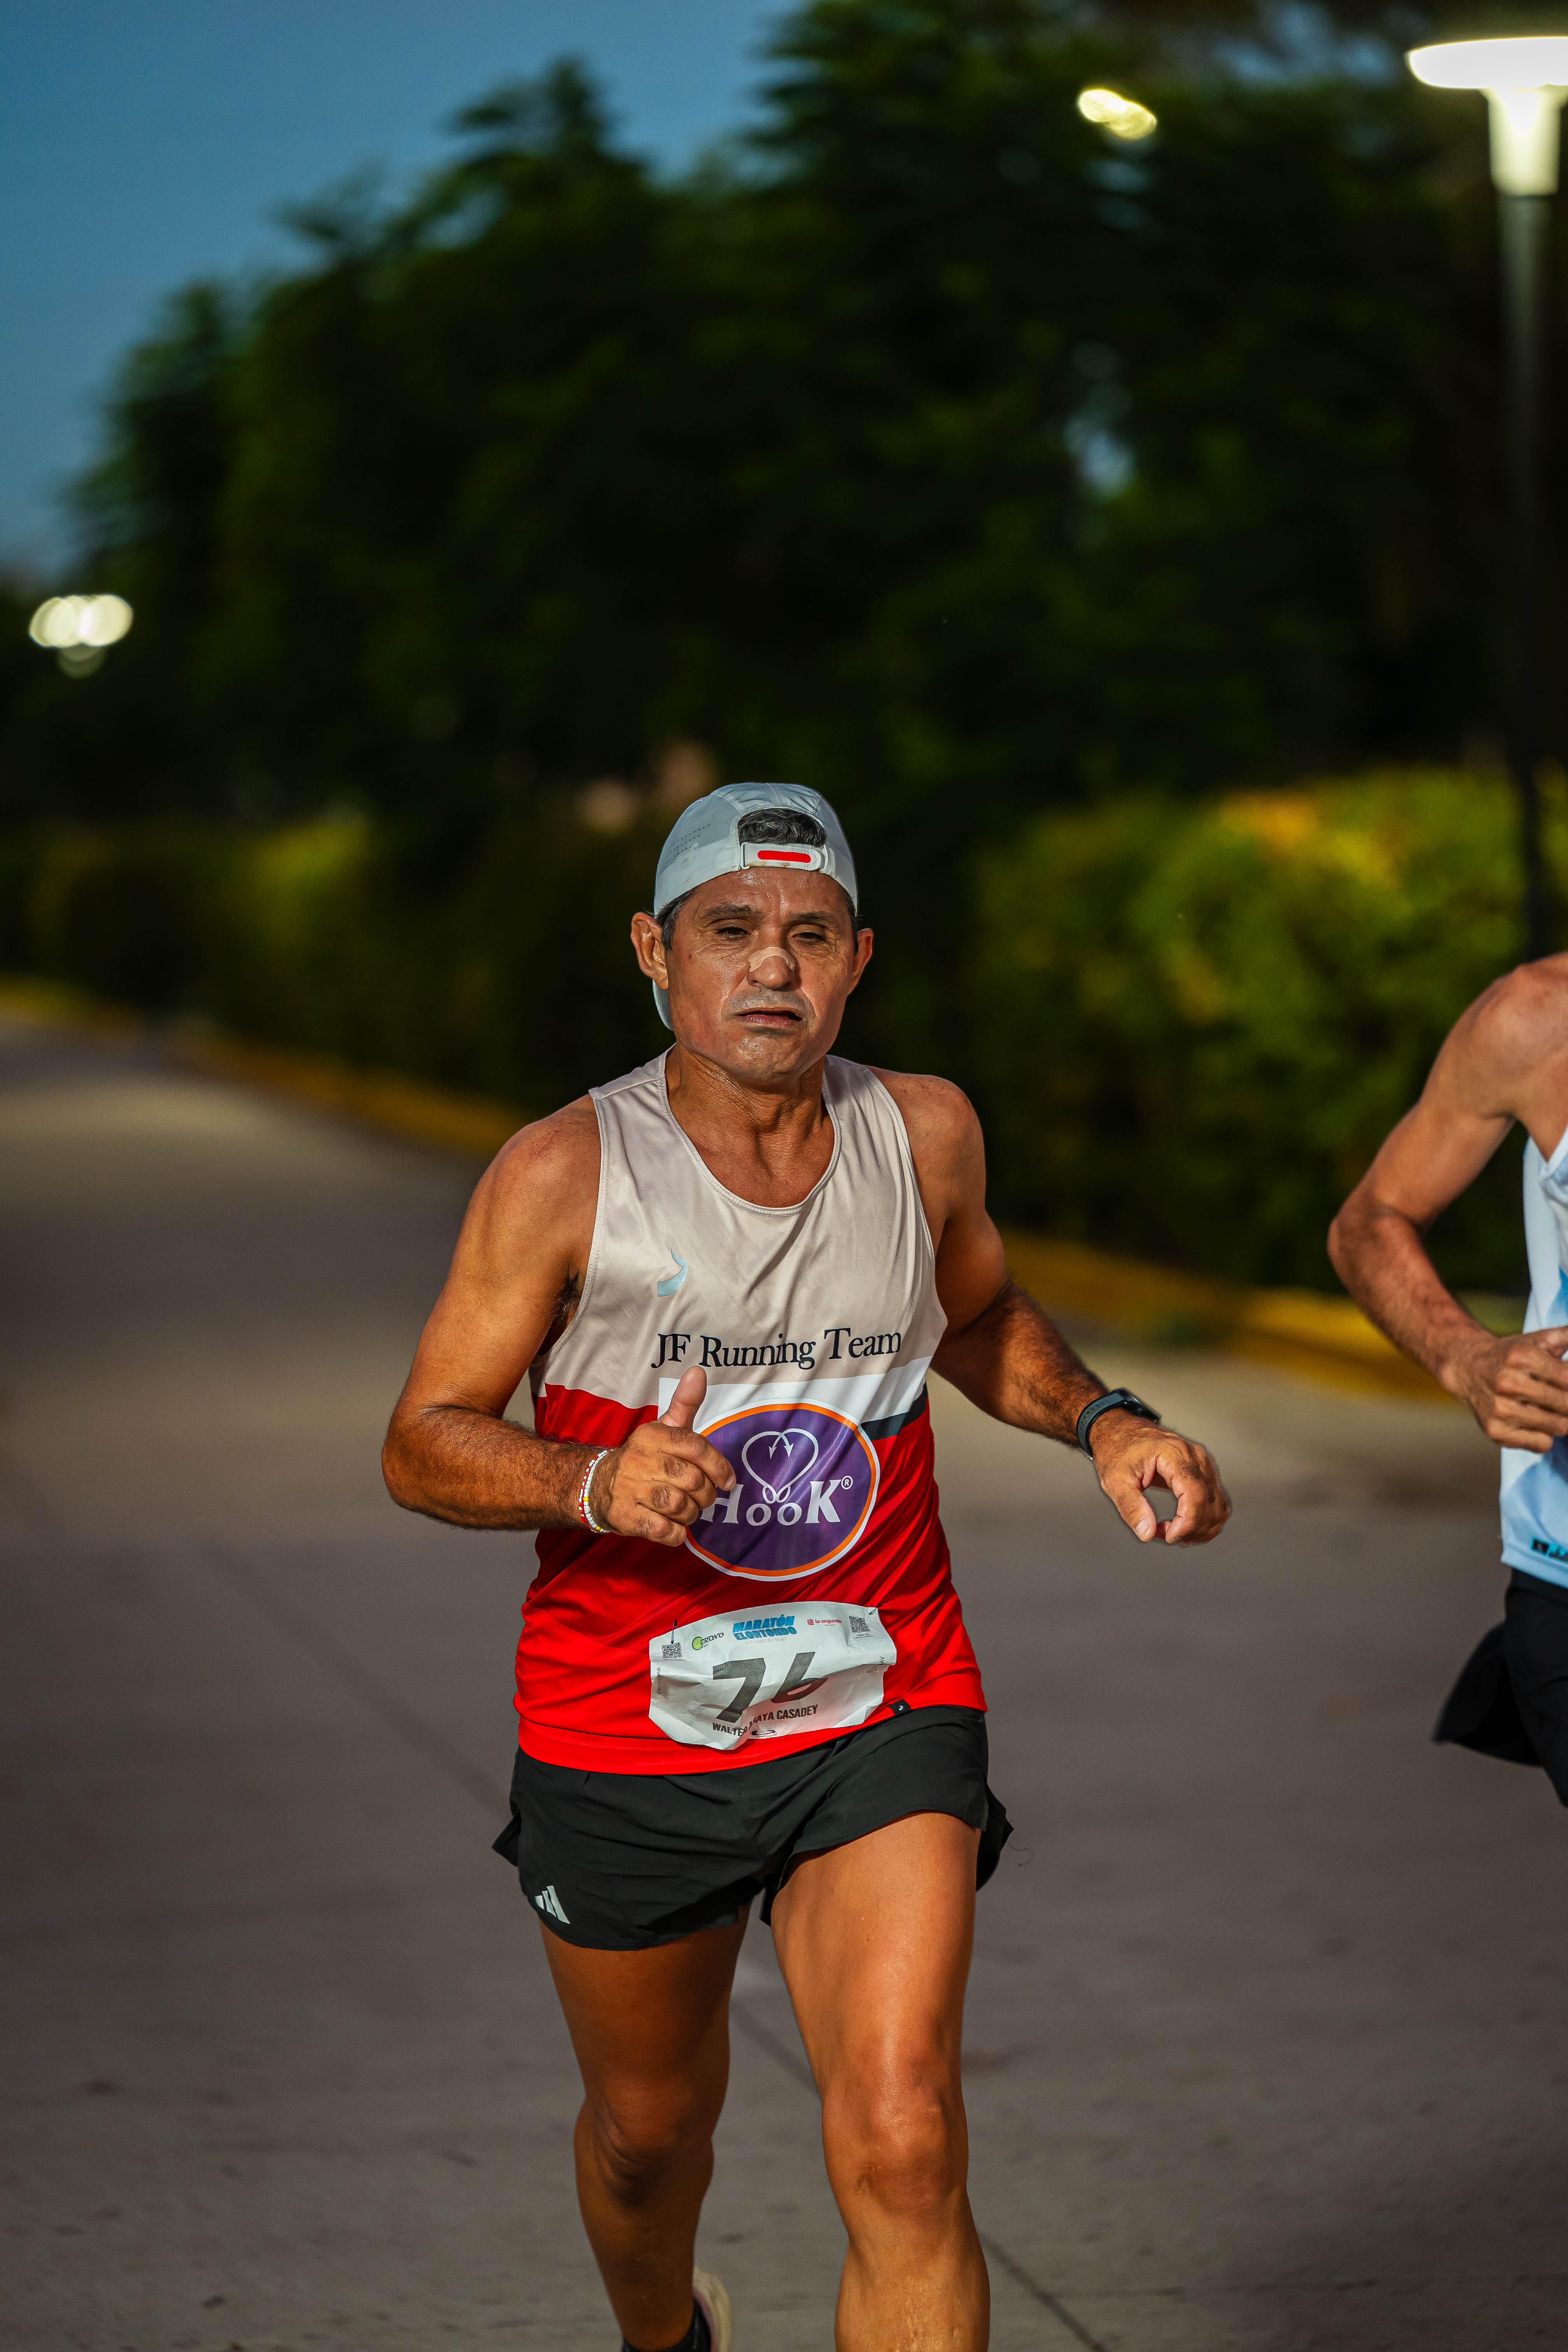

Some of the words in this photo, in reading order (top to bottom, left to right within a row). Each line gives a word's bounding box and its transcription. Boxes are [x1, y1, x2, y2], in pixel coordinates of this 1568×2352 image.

[651, 1333, 691, 1368] JF
[698, 1333, 816, 1370] Running
[824, 1327, 901, 1360] Team
[732, 1614, 795, 1633] MARATÓN
[700, 1632, 724, 1645] CRONO
[713, 1652, 828, 1724] 76
[776, 1704, 818, 1720] CASADEY
